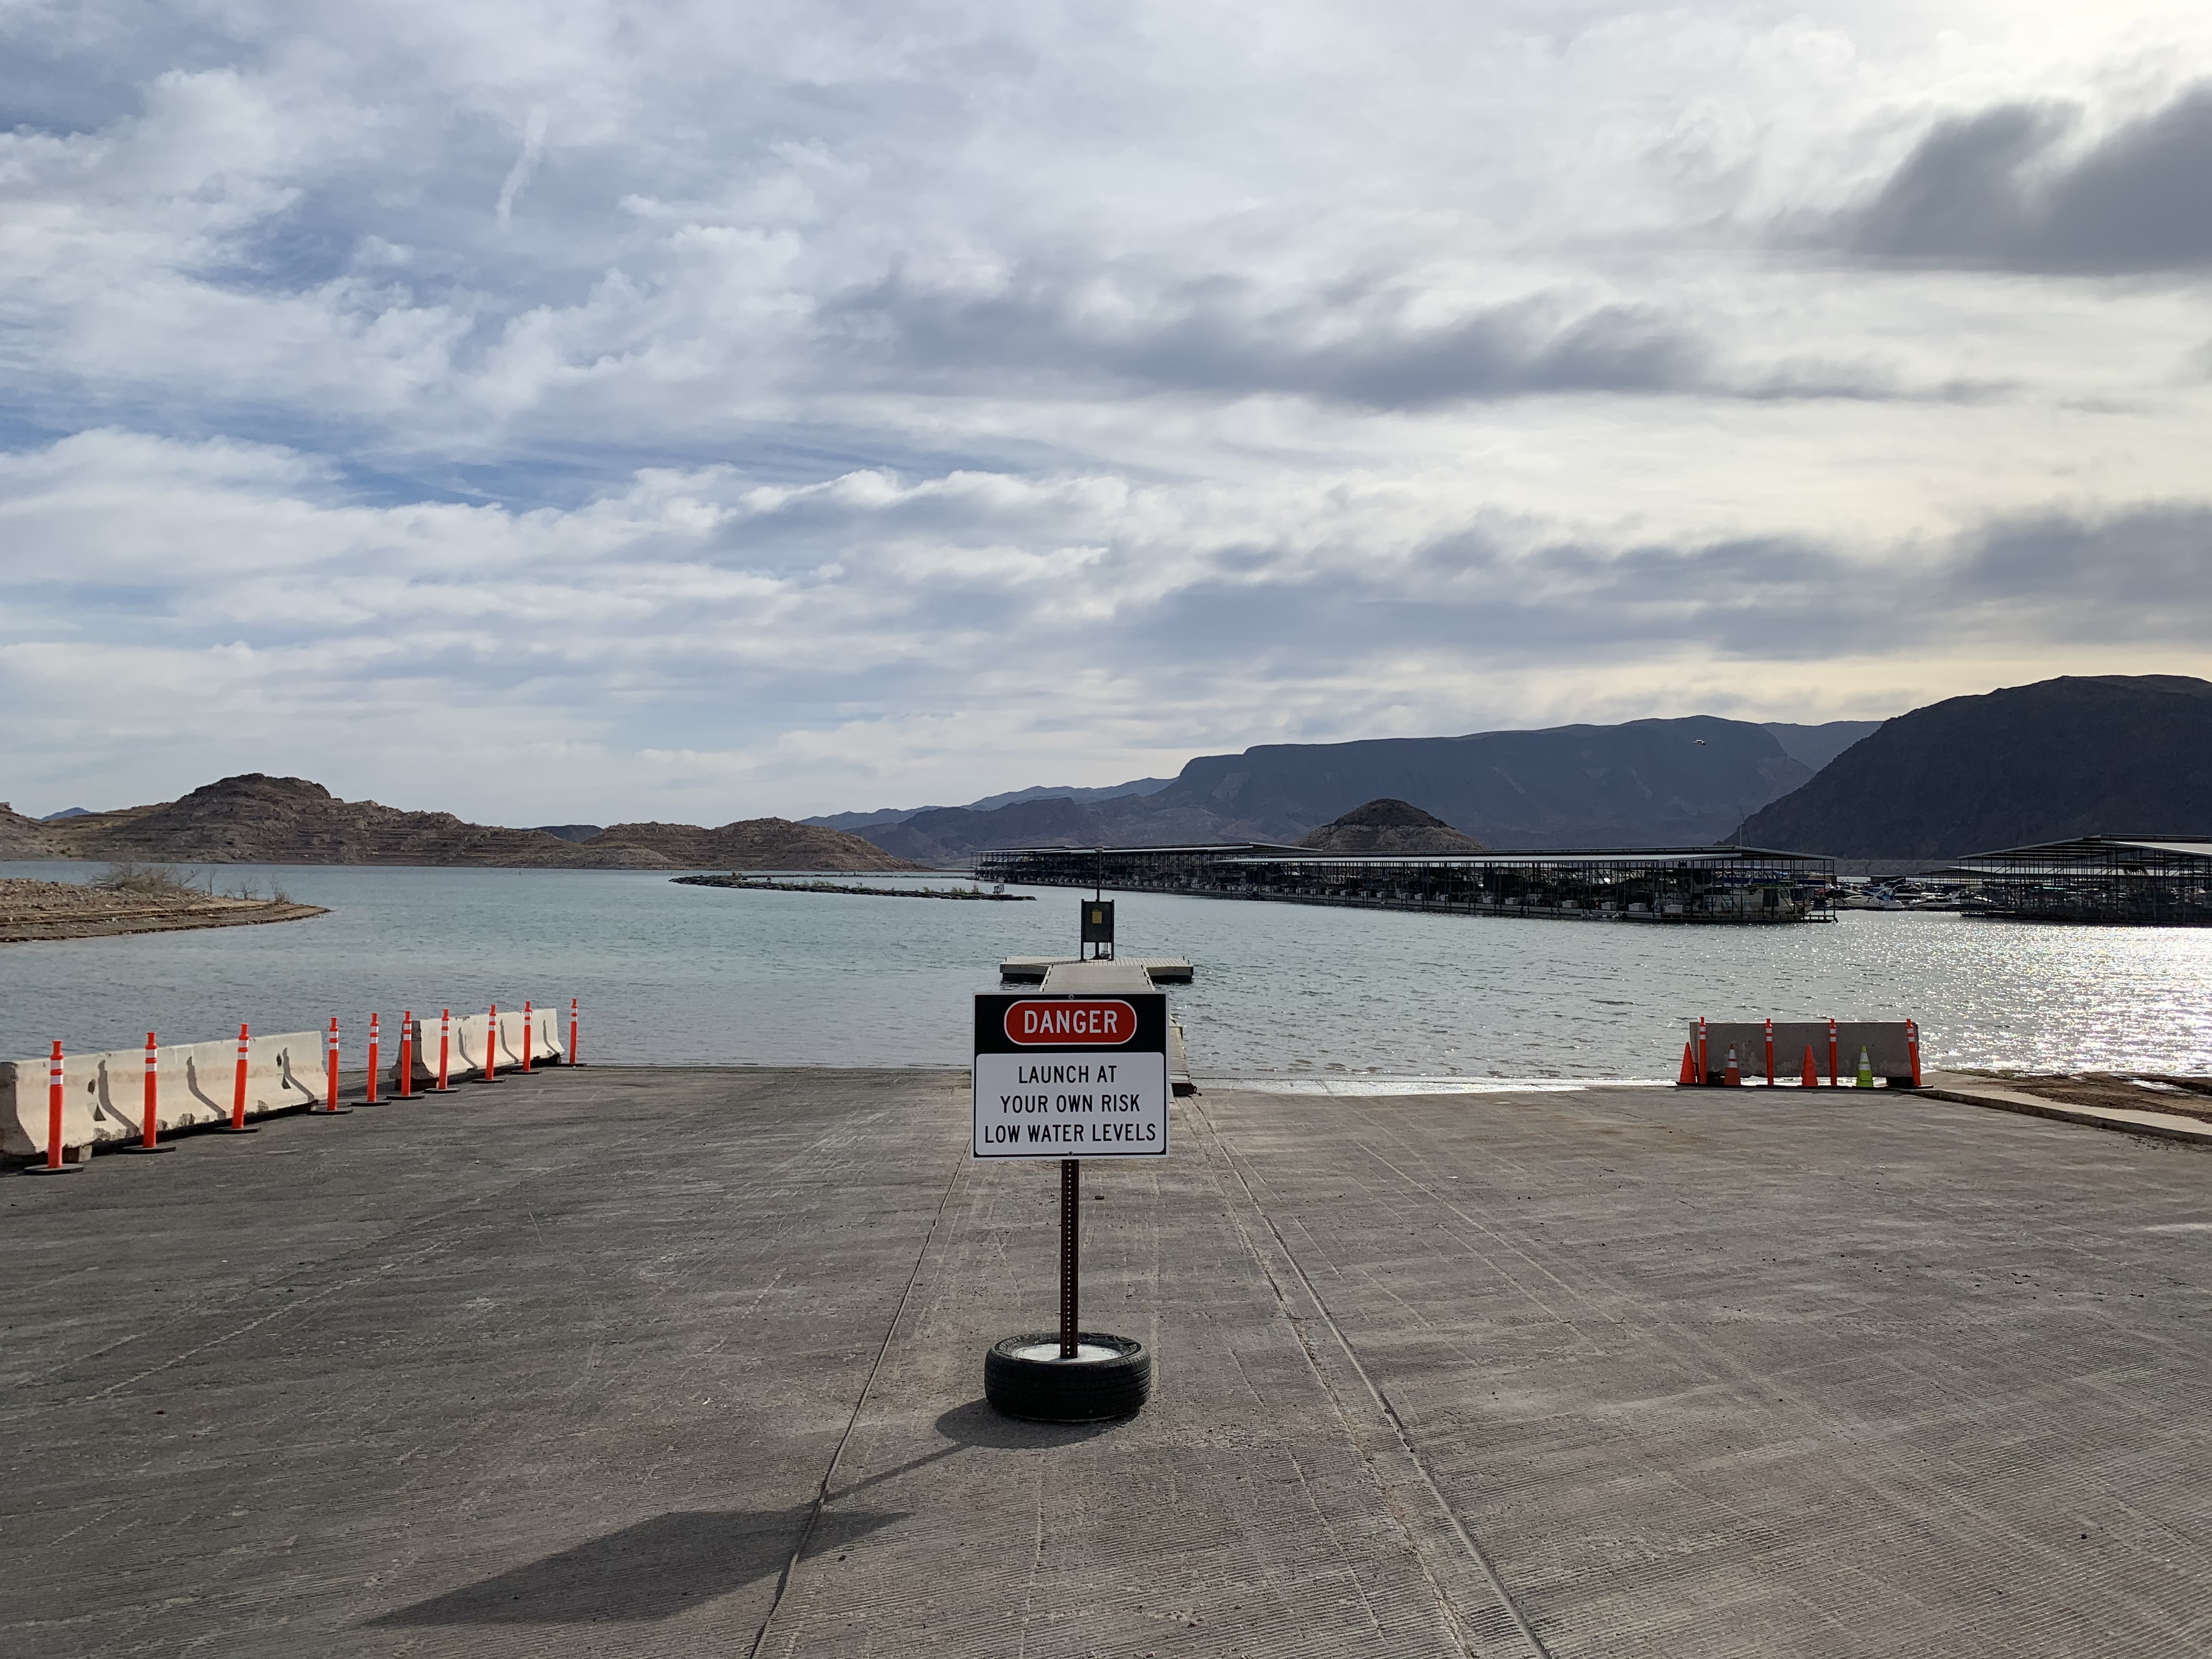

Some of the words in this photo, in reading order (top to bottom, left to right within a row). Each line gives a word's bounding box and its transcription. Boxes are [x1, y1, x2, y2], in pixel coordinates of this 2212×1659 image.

[1024, 1010, 1118, 1034] DANGER
[1019, 1065, 1089, 1084] LAUNCH
[1097, 1065, 1118, 1083] AT
[1000, 1095, 1048, 1114] YOUR
[1057, 1094, 1093, 1113] OWN
[1102, 1094, 1141, 1113] RISK
[985, 1125, 1021, 1143] LOW
[1028, 1124, 1084, 1143] WATER
[1092, 1123, 1156, 1142] LEVELS
